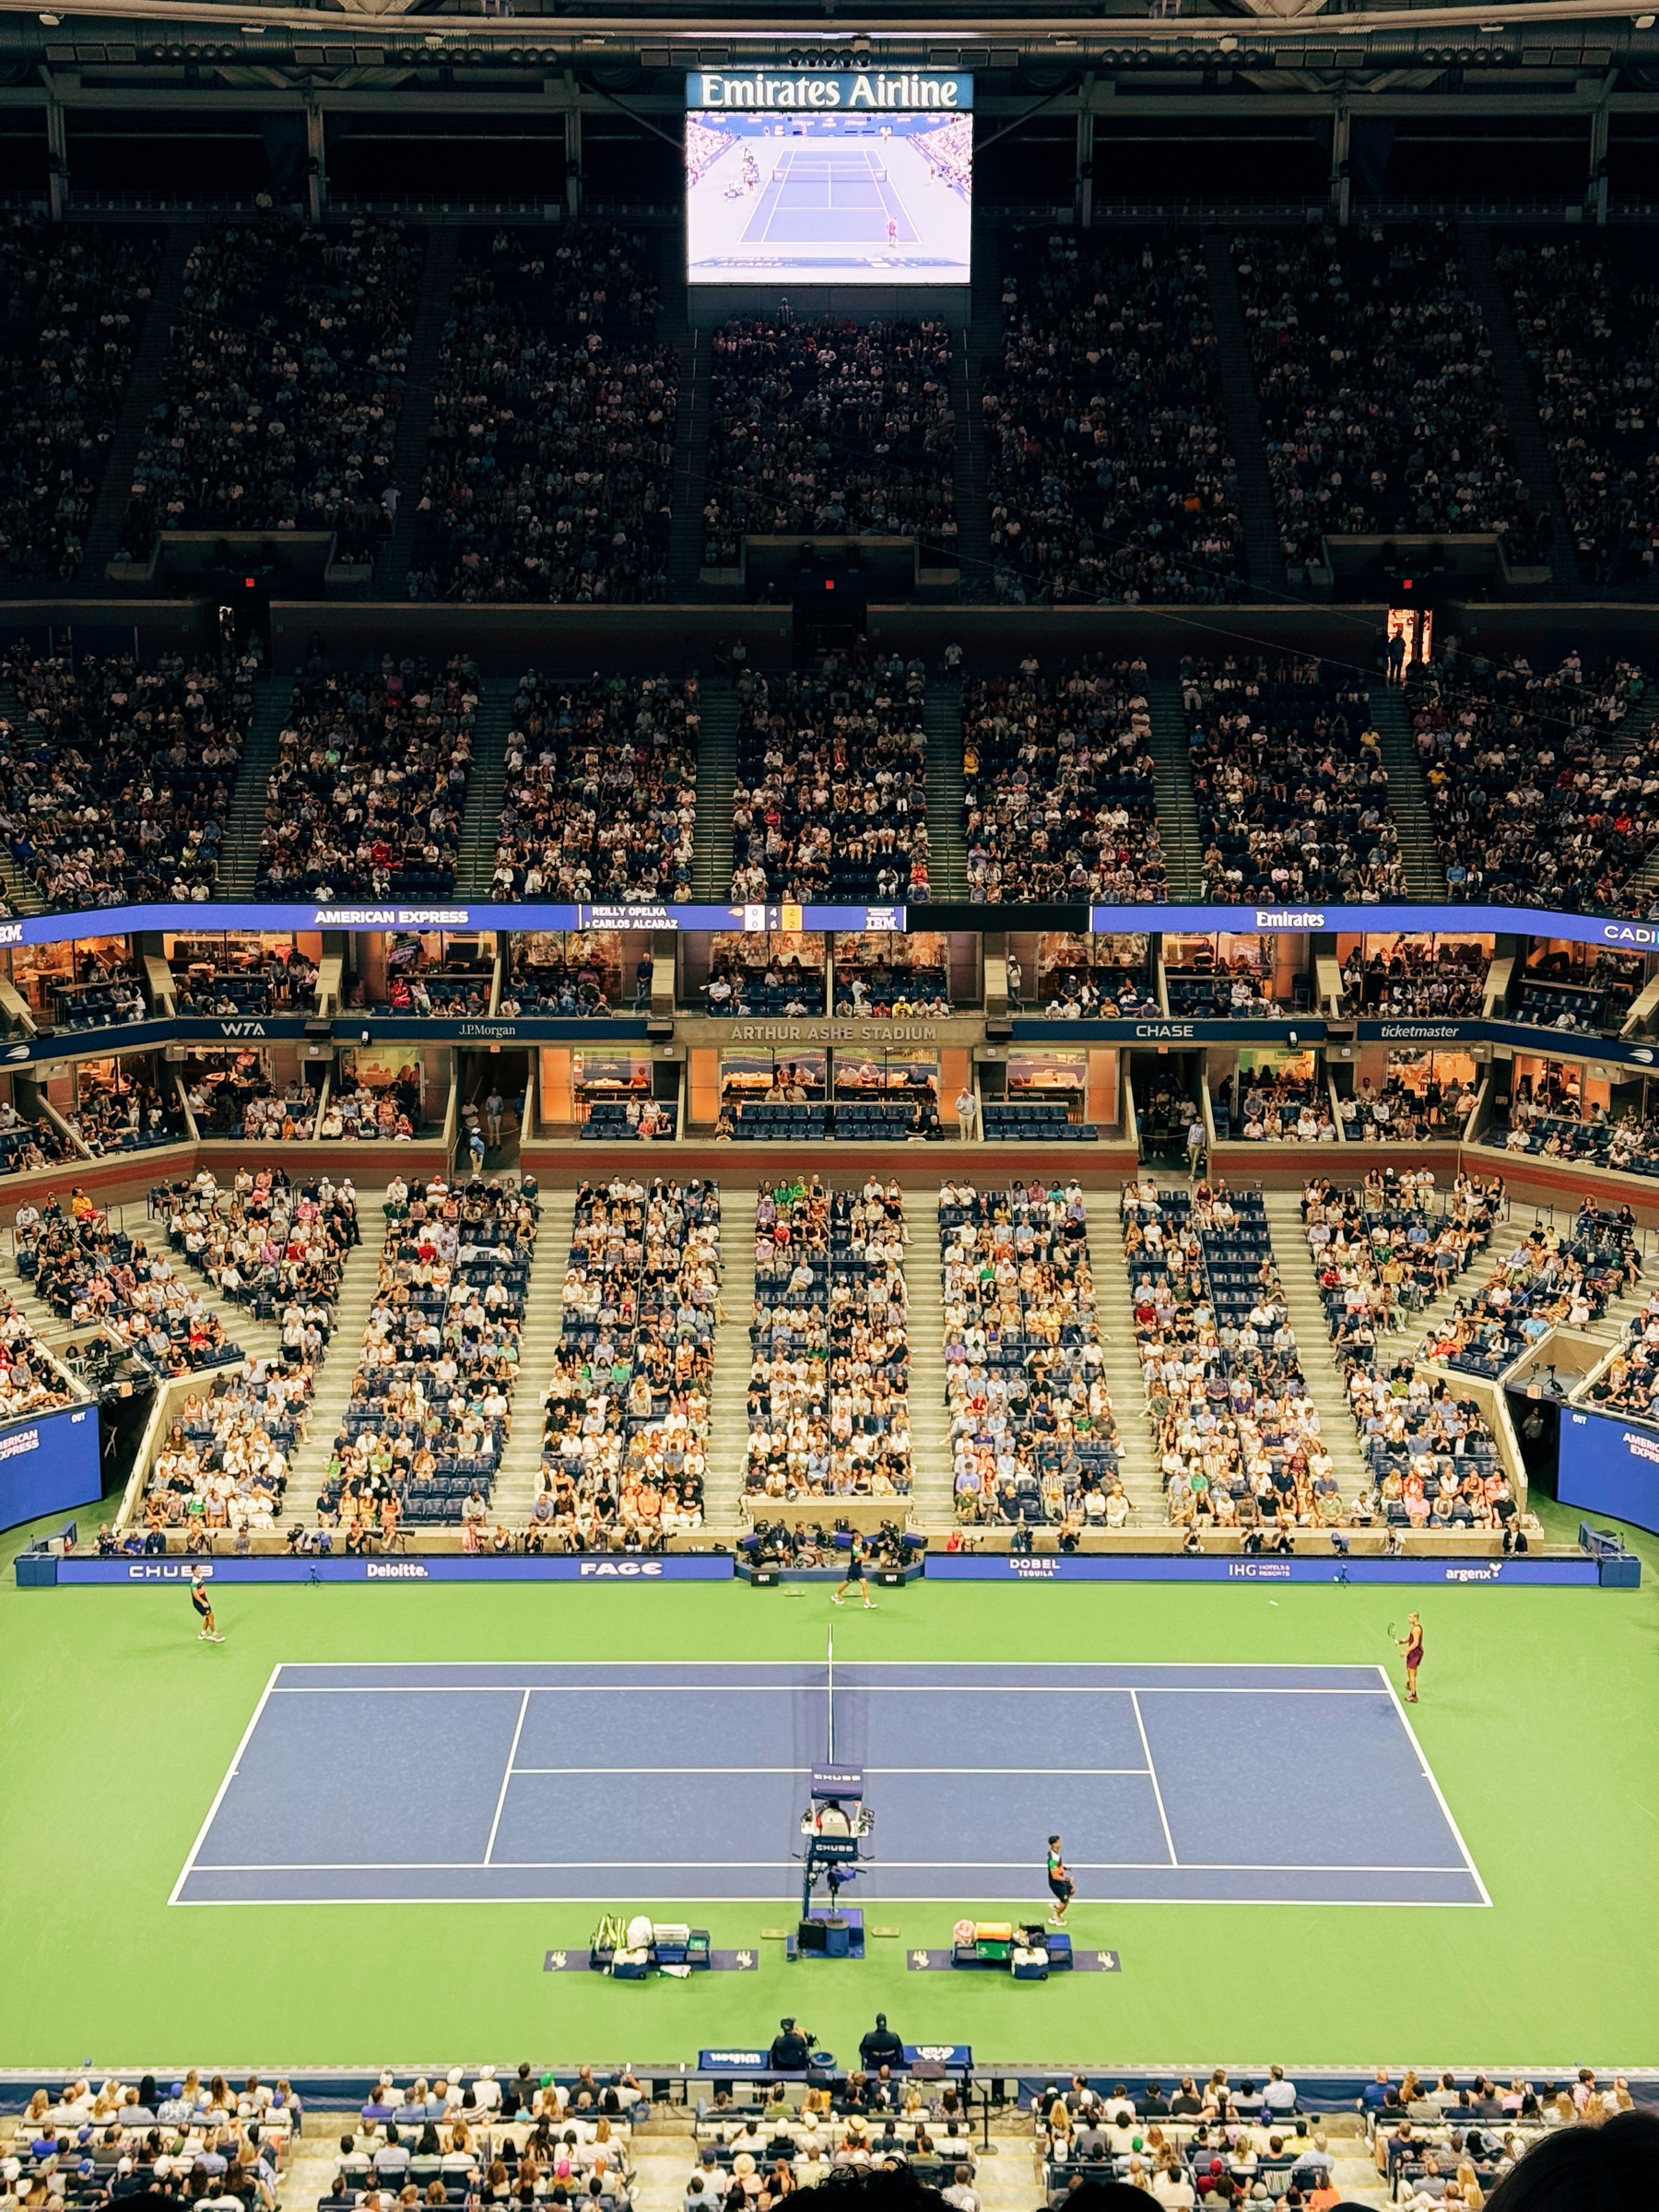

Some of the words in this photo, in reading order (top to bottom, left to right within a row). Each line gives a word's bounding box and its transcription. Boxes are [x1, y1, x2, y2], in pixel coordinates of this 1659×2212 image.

[701, 74, 840, 107] Emirates
[849, 74, 959, 107] Airline
[314, 911, 395, 924] AMERICAN
[398, 911, 469, 924] EXPRESS
[592, 906, 626, 917] REILLY
[628, 906, 666, 917] OPELKA
[751, 908, 758, 916] 0
[770, 907, 778, 917] 4
[789, 908, 795, 916] 2
[592, 919, 630, 929] CARLOS
[632, 919, 678, 929] ALCARAZ
[770, 920, 778, 930] 6
[866, 917, 899, 930] IBM
[1255, 911, 1325, 928] Emirates
[1604, 924, 1659, 945] CADI
[221, 1022, 265, 1037] WTA
[458, 1024, 516, 1039] J.P.Morgan
[731, 1026, 801, 1040] ARTHUR
[807, 1026, 853, 1040] ASHE
[862, 1026, 936, 1040] STADIUM
[1135, 1025, 1194, 1038] CHASE
[1381, 1025, 1460, 1039] ticketmaster
[71, 1411, 87, 1424] OUT
[1572, 1413, 1587, 1426] OUT
[0, 1439, 40, 1460] XPRESS
[366, 1563, 429, 1578] Deloitte.
[580, 1562, 663, 1576] FAGE
[1010, 1559, 1061, 1570] DOBEL
[1229, 1563, 1257, 1577] IHG
[1445, 1569, 1491, 1581] argenx
[710, 2053, 762, 2065] Wilson
